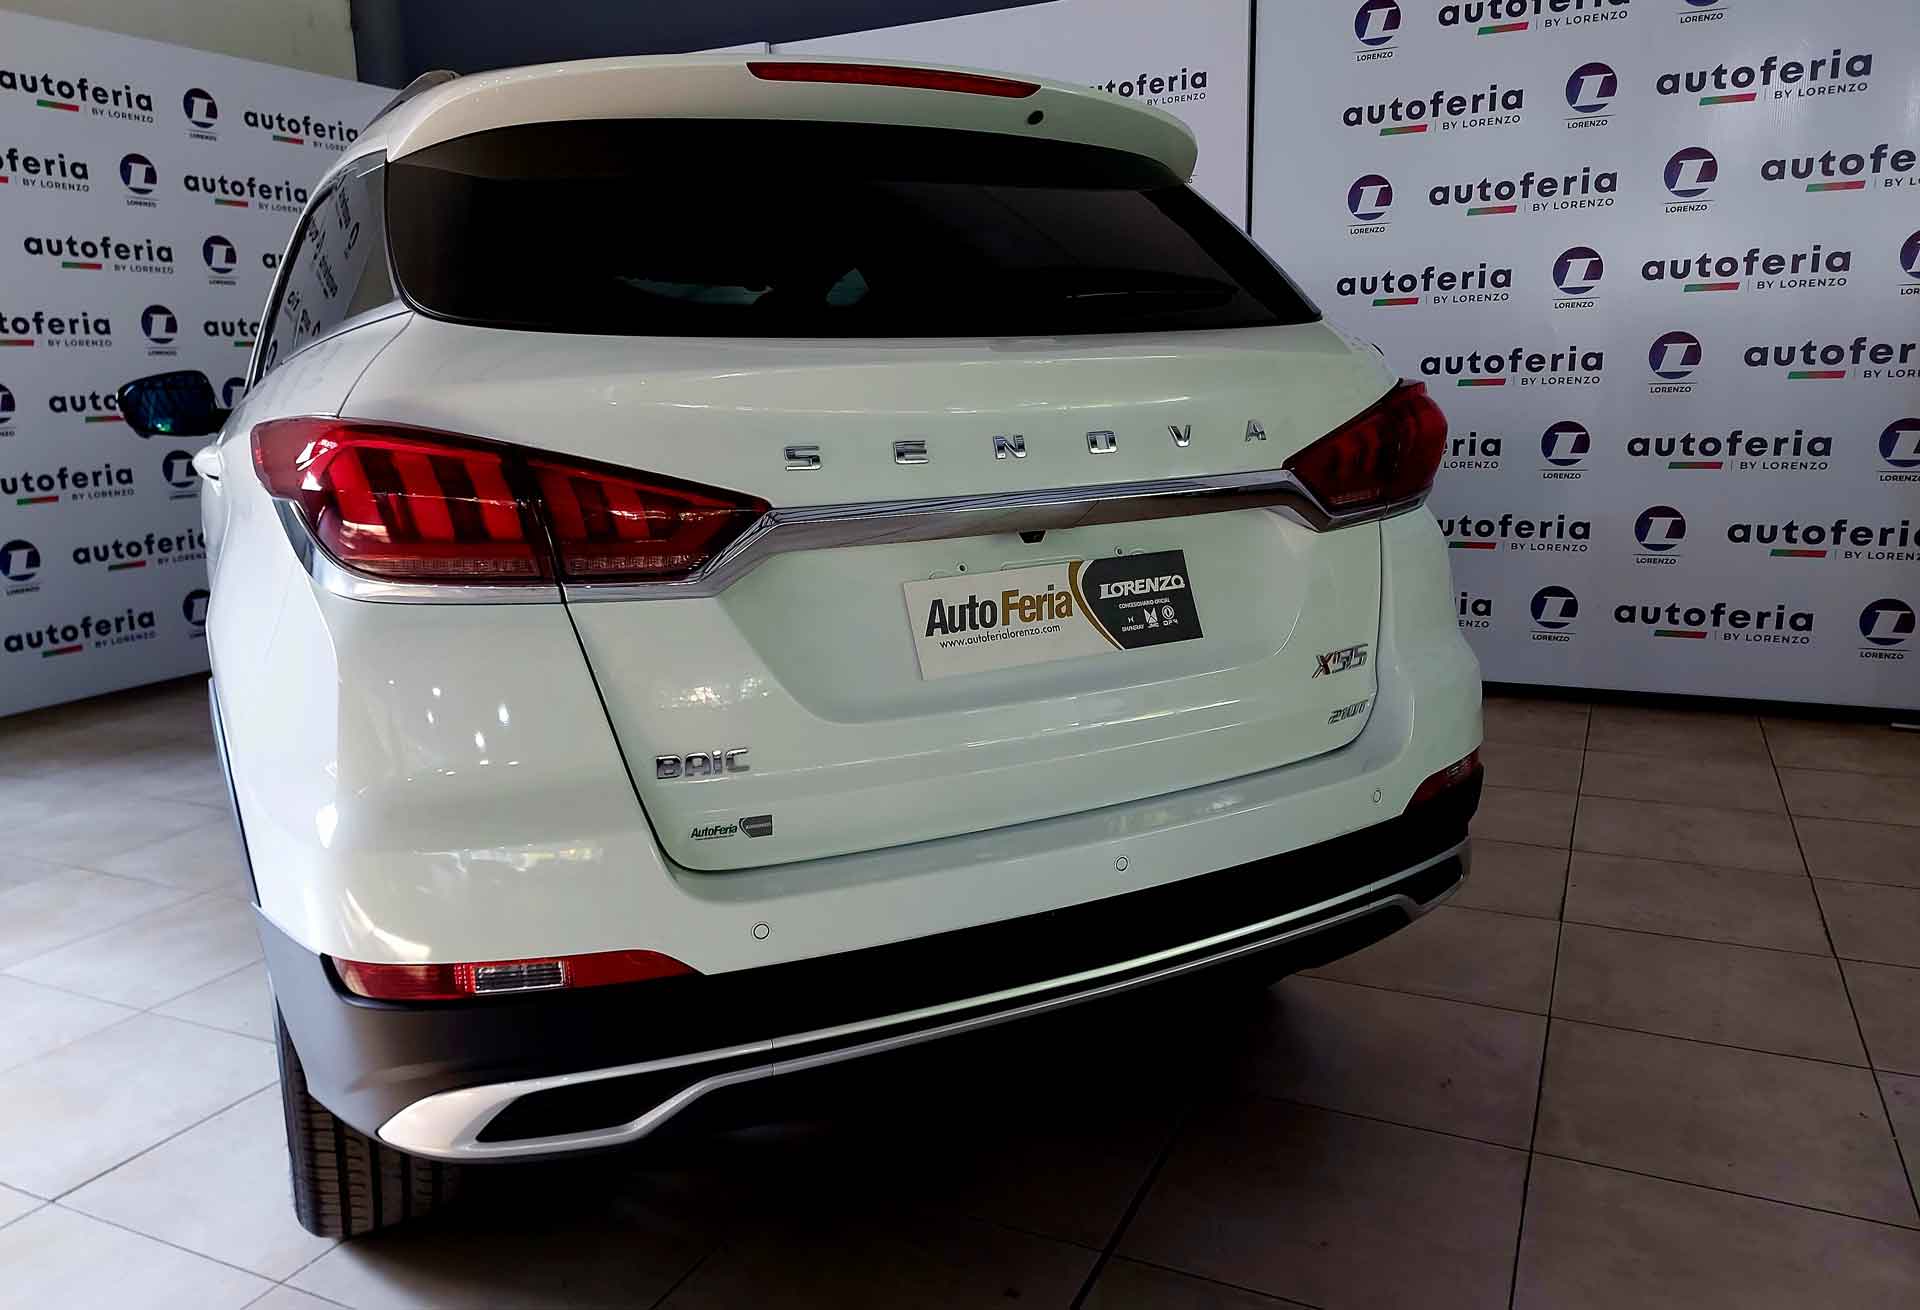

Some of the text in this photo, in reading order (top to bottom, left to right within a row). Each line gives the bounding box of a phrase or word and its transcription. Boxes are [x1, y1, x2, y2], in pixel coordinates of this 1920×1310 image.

[1545, 10, 1628, 28] BY LORENZO
[1680, 12, 1724, 24] LORENZO
[1357, 51, 1393, 62] LORENZO
[1656, 49, 1873, 95] autoferia
[0, 70, 152, 111] autoferia
[1774, 82, 1868, 99] BY LORENZO
[1162, 92, 1206, 104] LORENZO
[1343, 84, 1524, 126] autoferia
[92, 108, 153, 123] BY LORENZO
[245, 111, 358, 143] autoferia
[1443, 115, 1521, 130] BY LORENZO
[1568, 119, 1608, 129] LORENZO
[23, 178, 89, 192] BY LORENZO
[184, 175, 307, 203] autoferia
[1429, 166, 1618, 206] autoferia
[1884, 178, 1902, 188] BY
[1533, 198, 1615, 212] BY LORENZO
[1665, 204, 1708, 213] LORENZO
[1350, 227, 1385, 235] LORENZO
[24, 236, 172, 262] autoferia
[130, 265, 173, 274] LORENZO
[1641, 245, 1851, 281] autoferia
[1337, 263, 1512, 296] autoferia
[1757, 277, 1847, 289] BY LORENZO
[1434, 292, 1510, 304] BY LORENZO
[1554, 301, 1594, 309] LORENZO
[65, 340, 112, 348] LORENZO
[1420, 345, 1603, 376] autoferia
[1541, 376, 1600, 385] LORENZO
[1863, 370, 1880, 378] BY
[784, 419, 1267, 471] SENOVA
[1627, 429, 1832, 457] autoferia
[1443, 461, 1499, 469] LORENZO
[1740, 461, 1828, 470] BY LORENZO
[88, 489, 134, 500] LORENZO
[1530, 543, 1587, 552] LORENZO
[1636, 557, 1677, 565] LORENZO
[1844, 551, 1863, 560] BY
[1099, 575, 1185, 599] LORENZO
[1614, 603, 1815, 632] autoferia
[4, 609, 155, 652] autoferia
[939, 623, 1061, 649] www.autoferialorenzo.com
[111, 631, 156, 646] LORENZO
[1532, 634, 1570, 642] LORENZO
[1723, 633, 1810, 645] BY LORENZO
[1859, 651, 1904, 660] LORENZO
